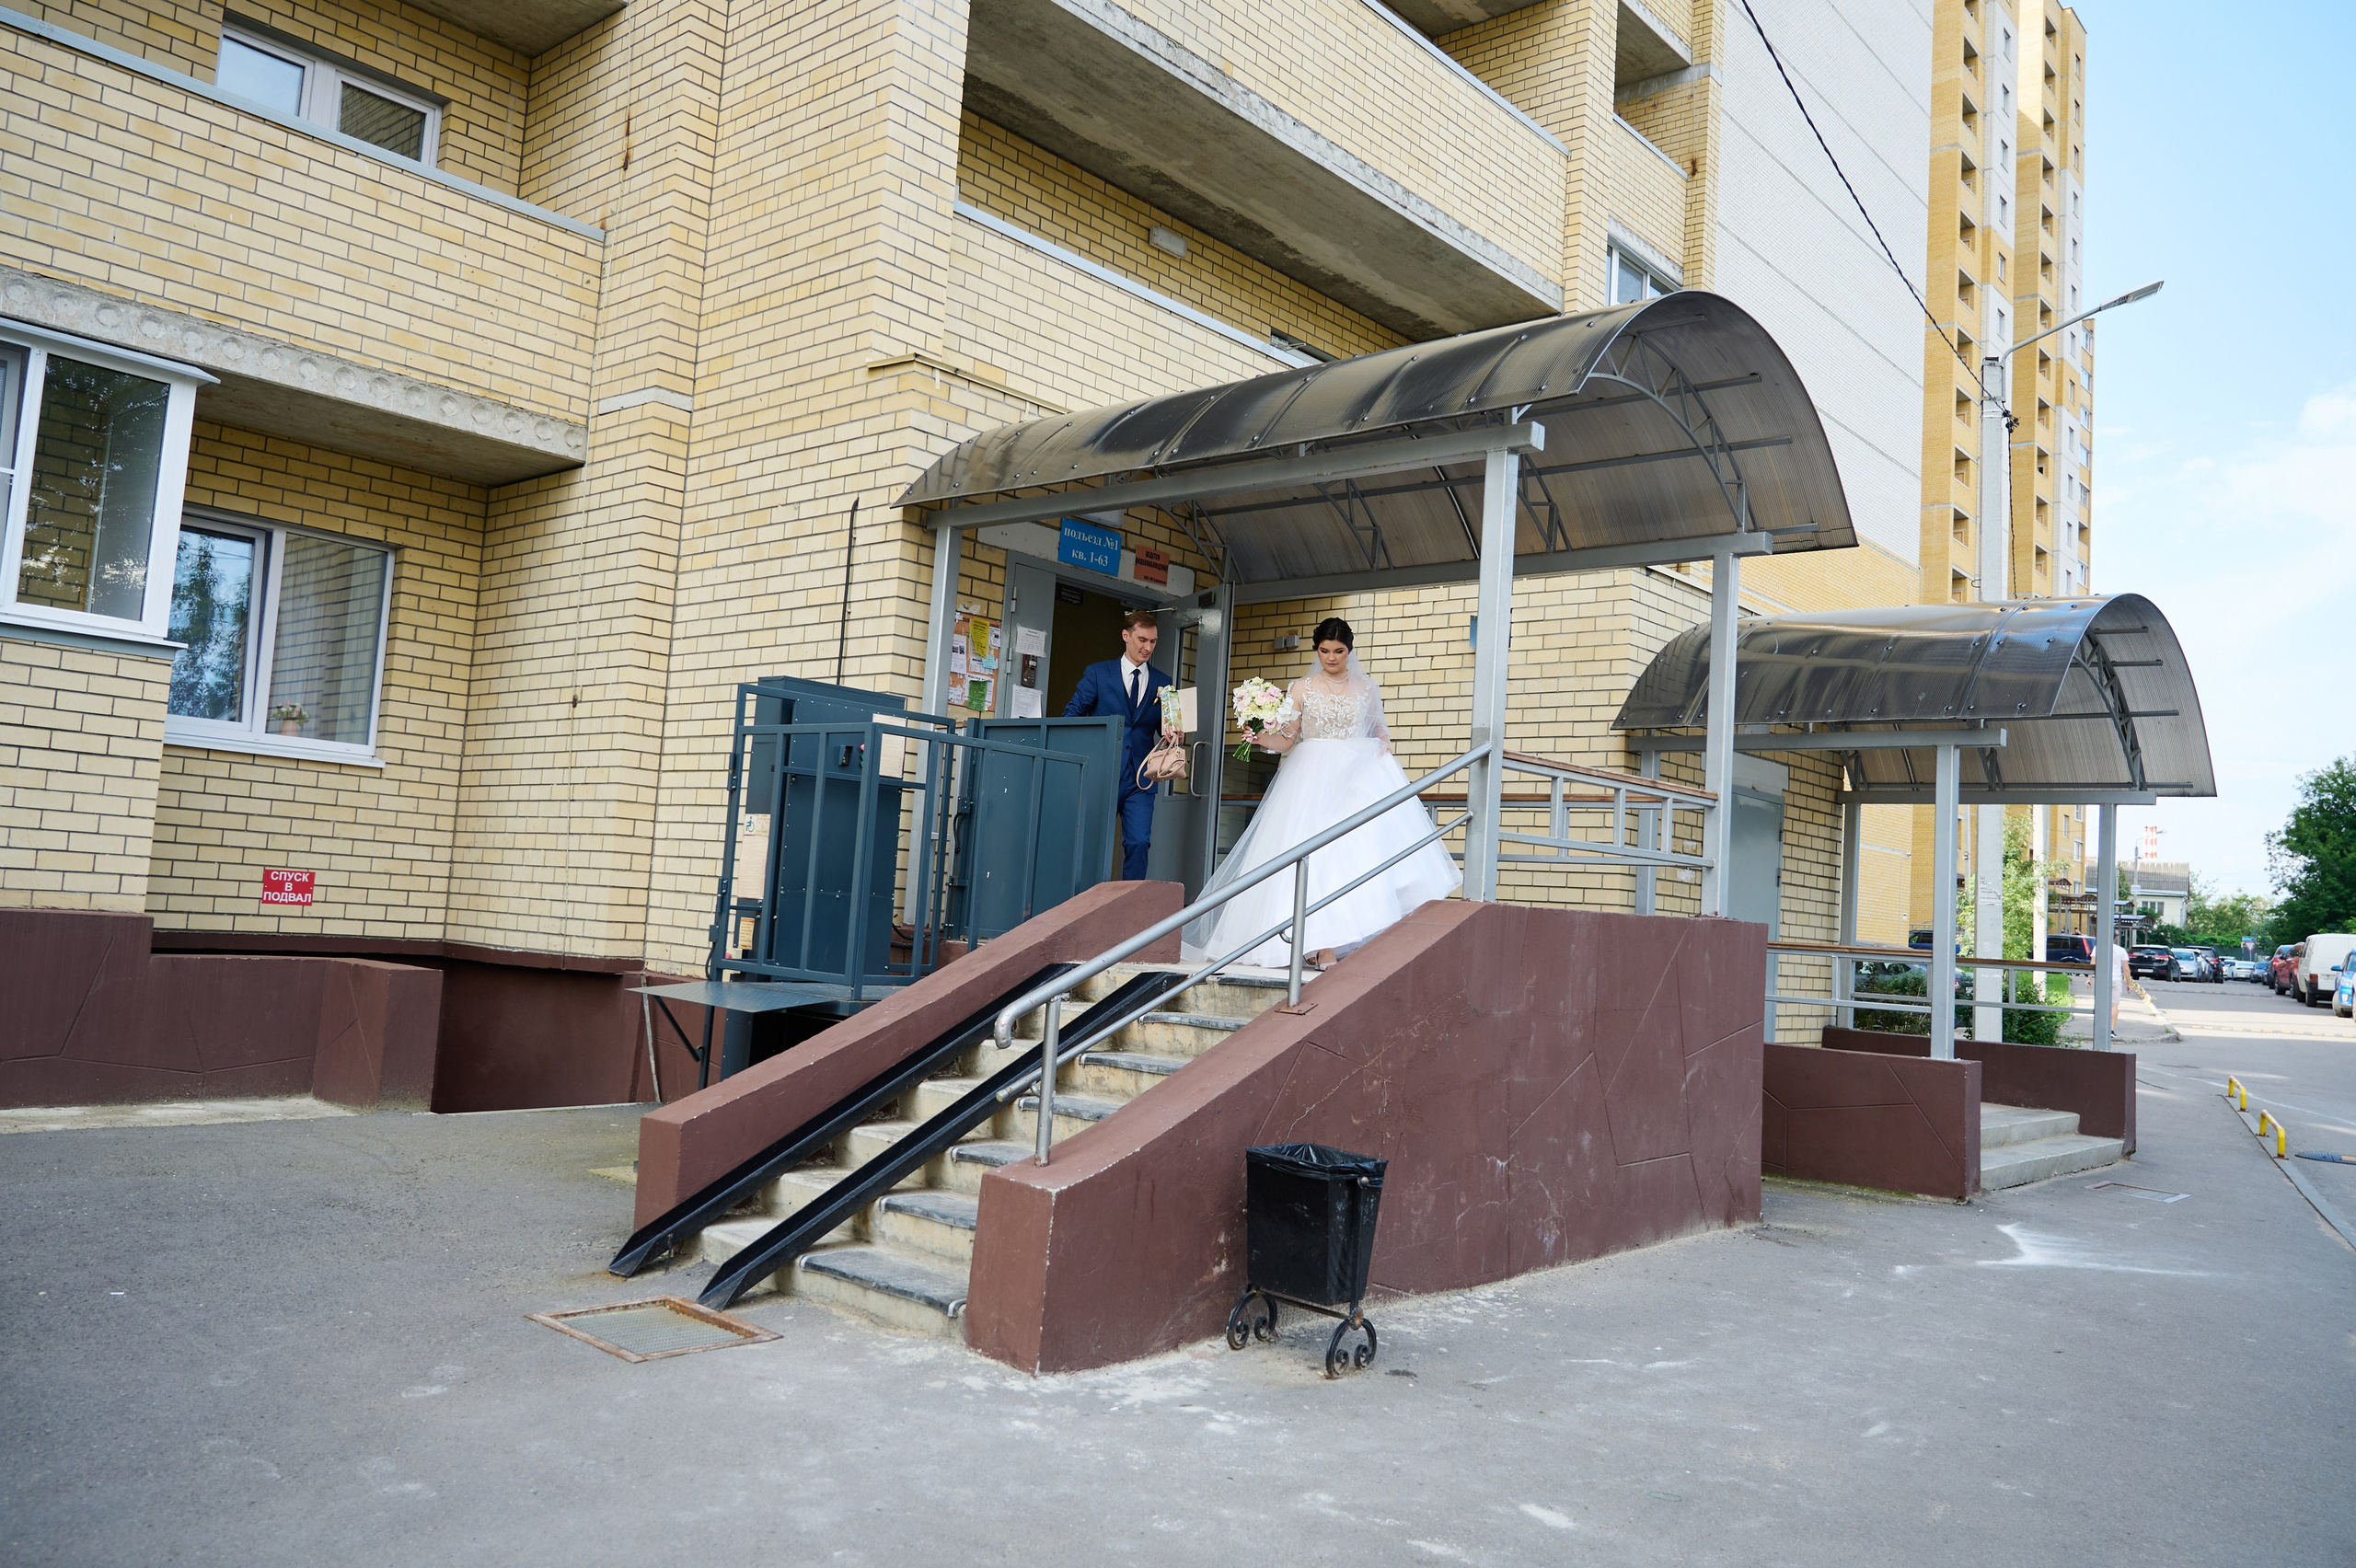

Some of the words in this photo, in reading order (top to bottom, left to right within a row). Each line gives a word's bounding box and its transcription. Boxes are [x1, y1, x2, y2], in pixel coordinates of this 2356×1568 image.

[1064, 527, 1102, 547] подъезд
[1103, 536, 1118, 551] №1
[1071, 549, 1087, 561] кв.
[1090, 552, 1108, 566] 1-63
[271, 871, 309, 882] СПУСК
[284, 882, 293, 891] В
[263, 892, 311, 903] ПОДВАЛ
